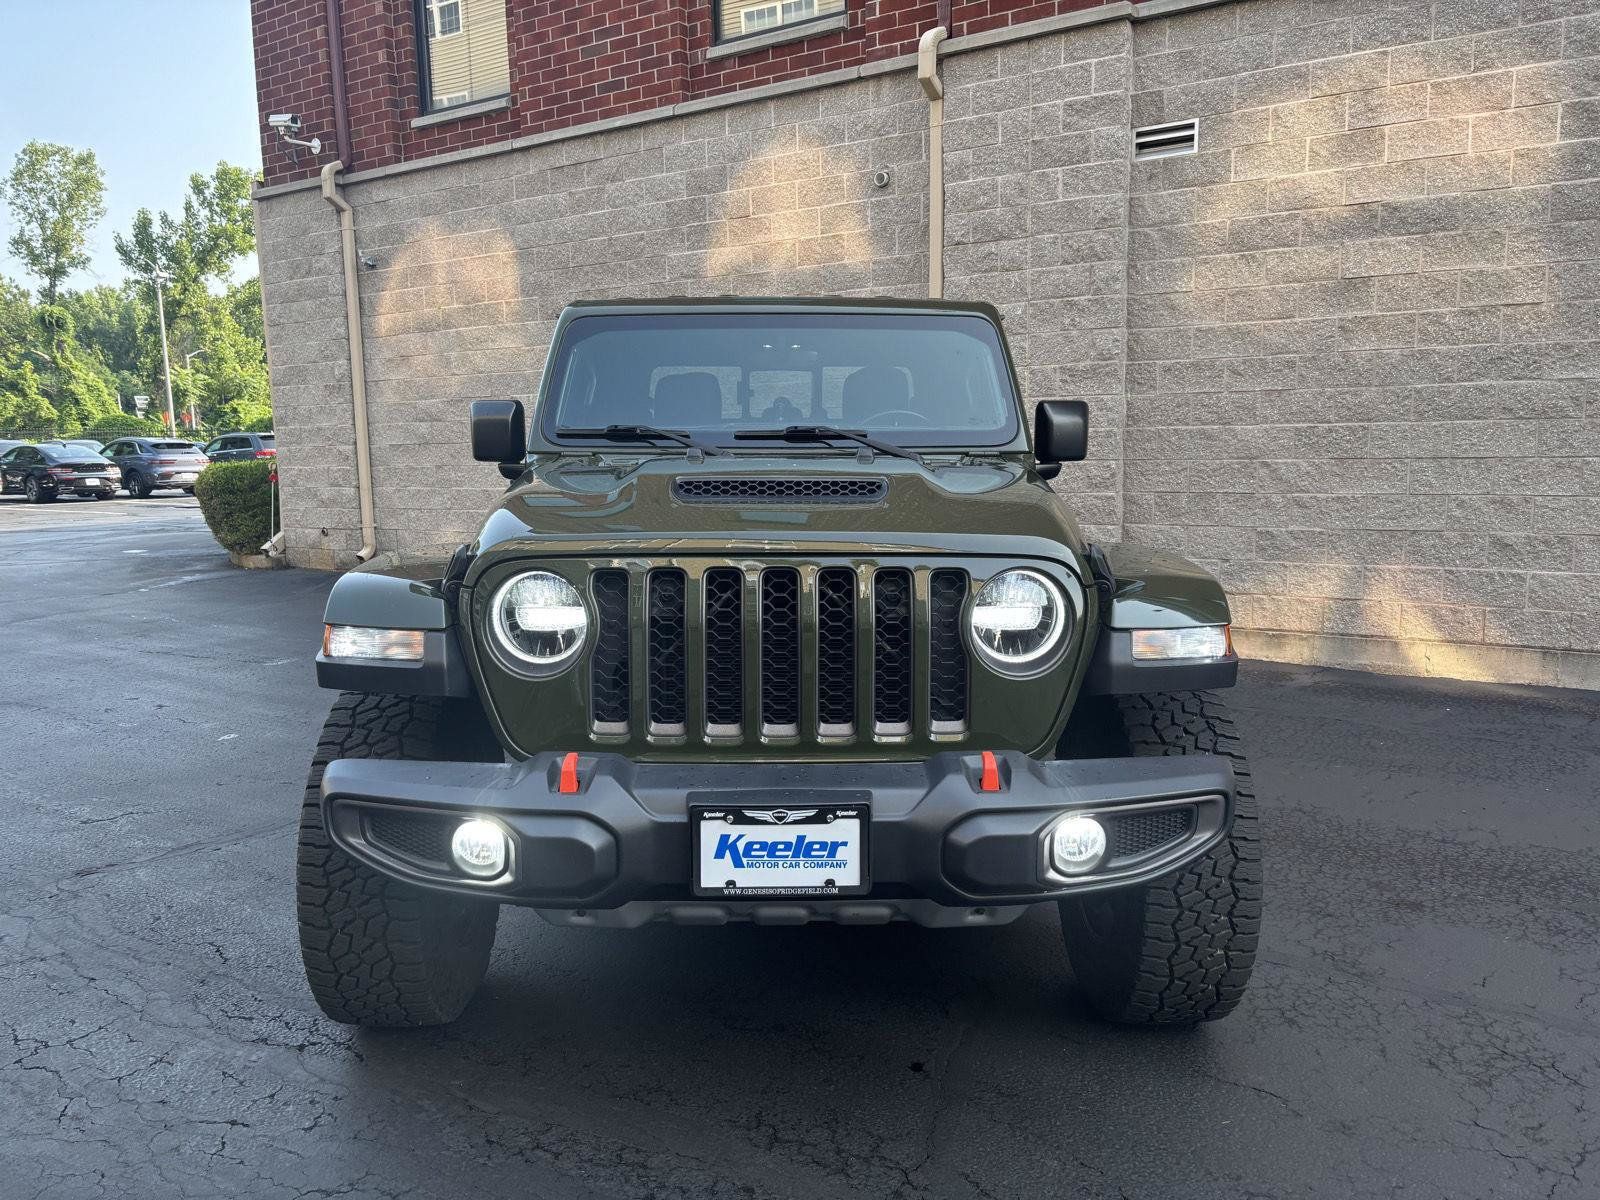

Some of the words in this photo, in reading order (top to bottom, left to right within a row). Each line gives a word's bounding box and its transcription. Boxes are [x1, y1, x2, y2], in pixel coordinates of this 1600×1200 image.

[713, 833, 849, 869] Keeler
[746, 861, 780, 869] MOTOR
[781, 861, 801, 869] CAR
[803, 861, 848, 869] COMPANY
[722, 887, 839, 895] WWW.GENESISOFRIDGEFIELD.COM
